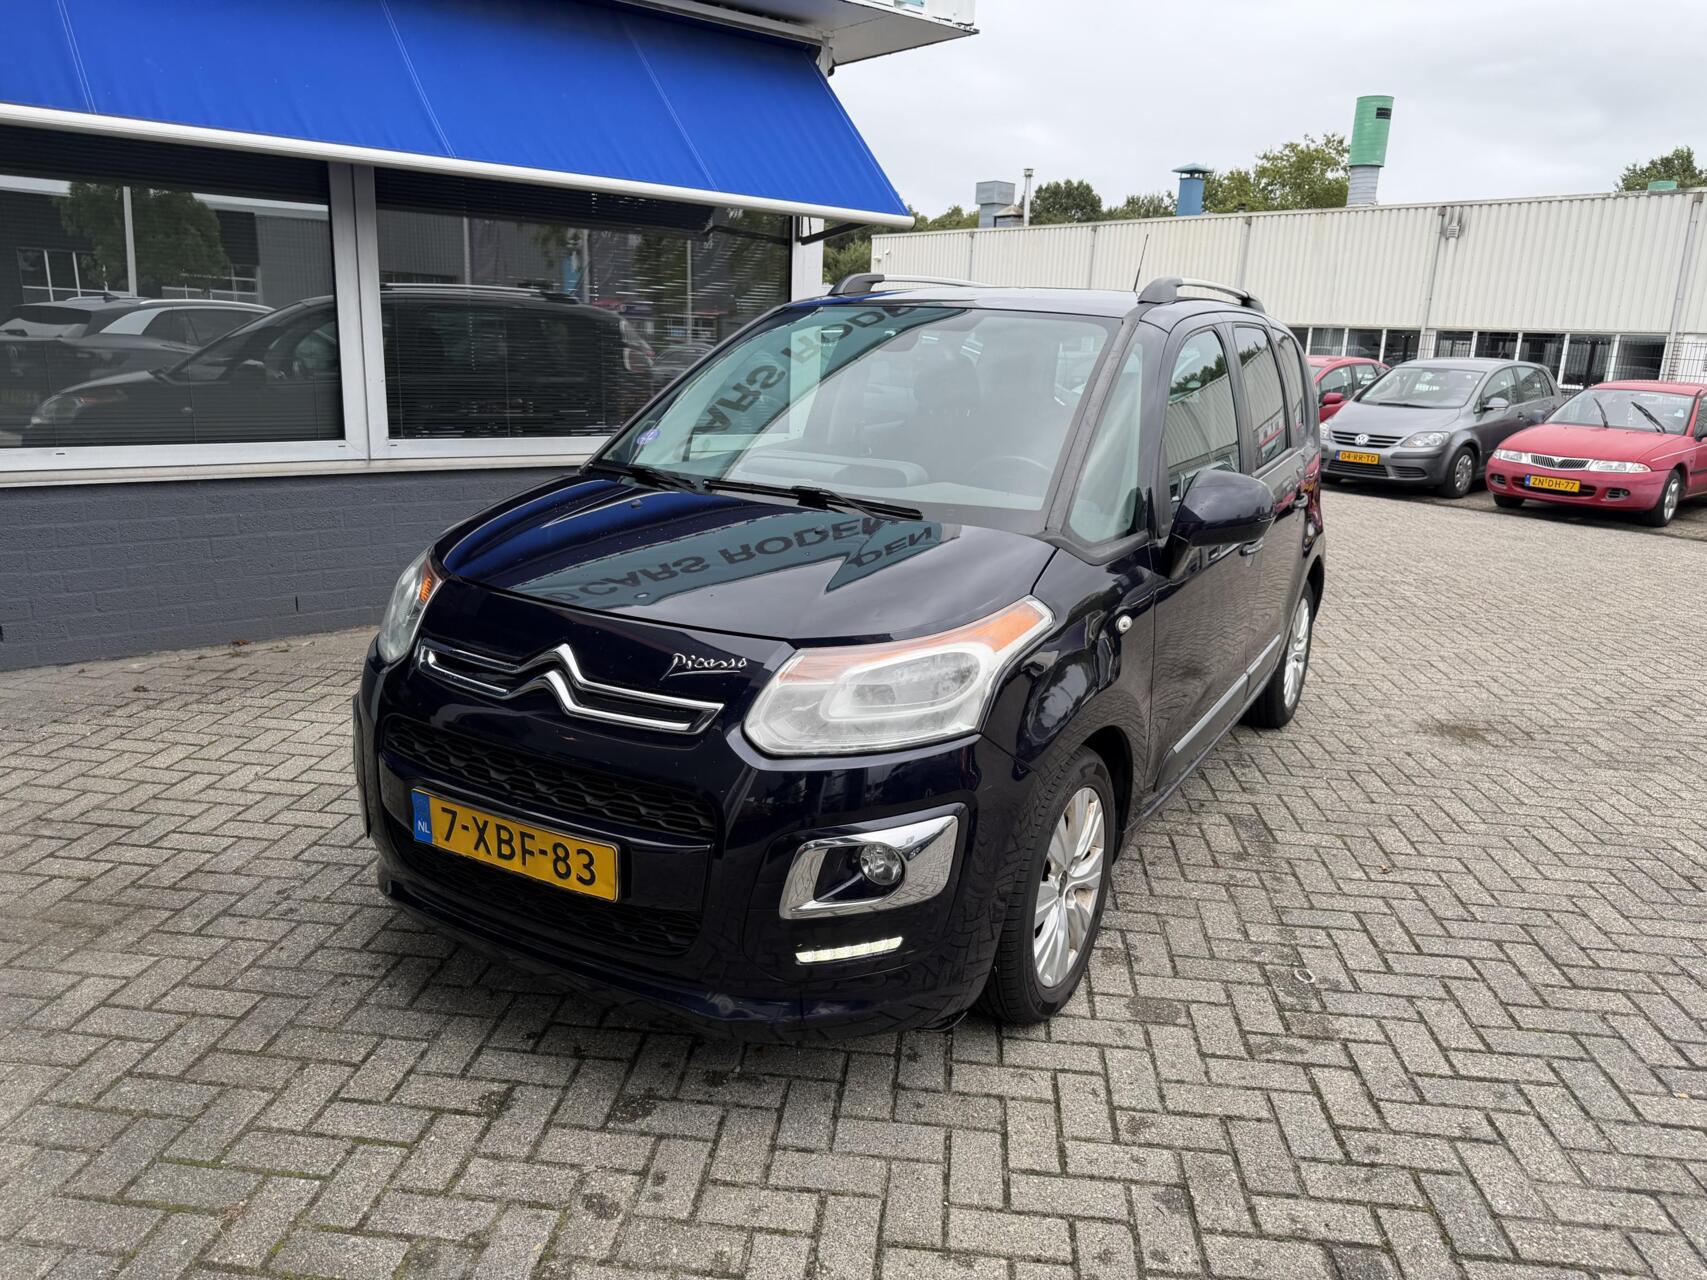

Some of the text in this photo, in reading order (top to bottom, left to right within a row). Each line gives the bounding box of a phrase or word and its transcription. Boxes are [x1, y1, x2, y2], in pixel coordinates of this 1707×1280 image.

[660, 652, 748, 681] Picasso
[417, 819, 431, 834] NL
[440, 806, 597, 887] 7-XBF-83
